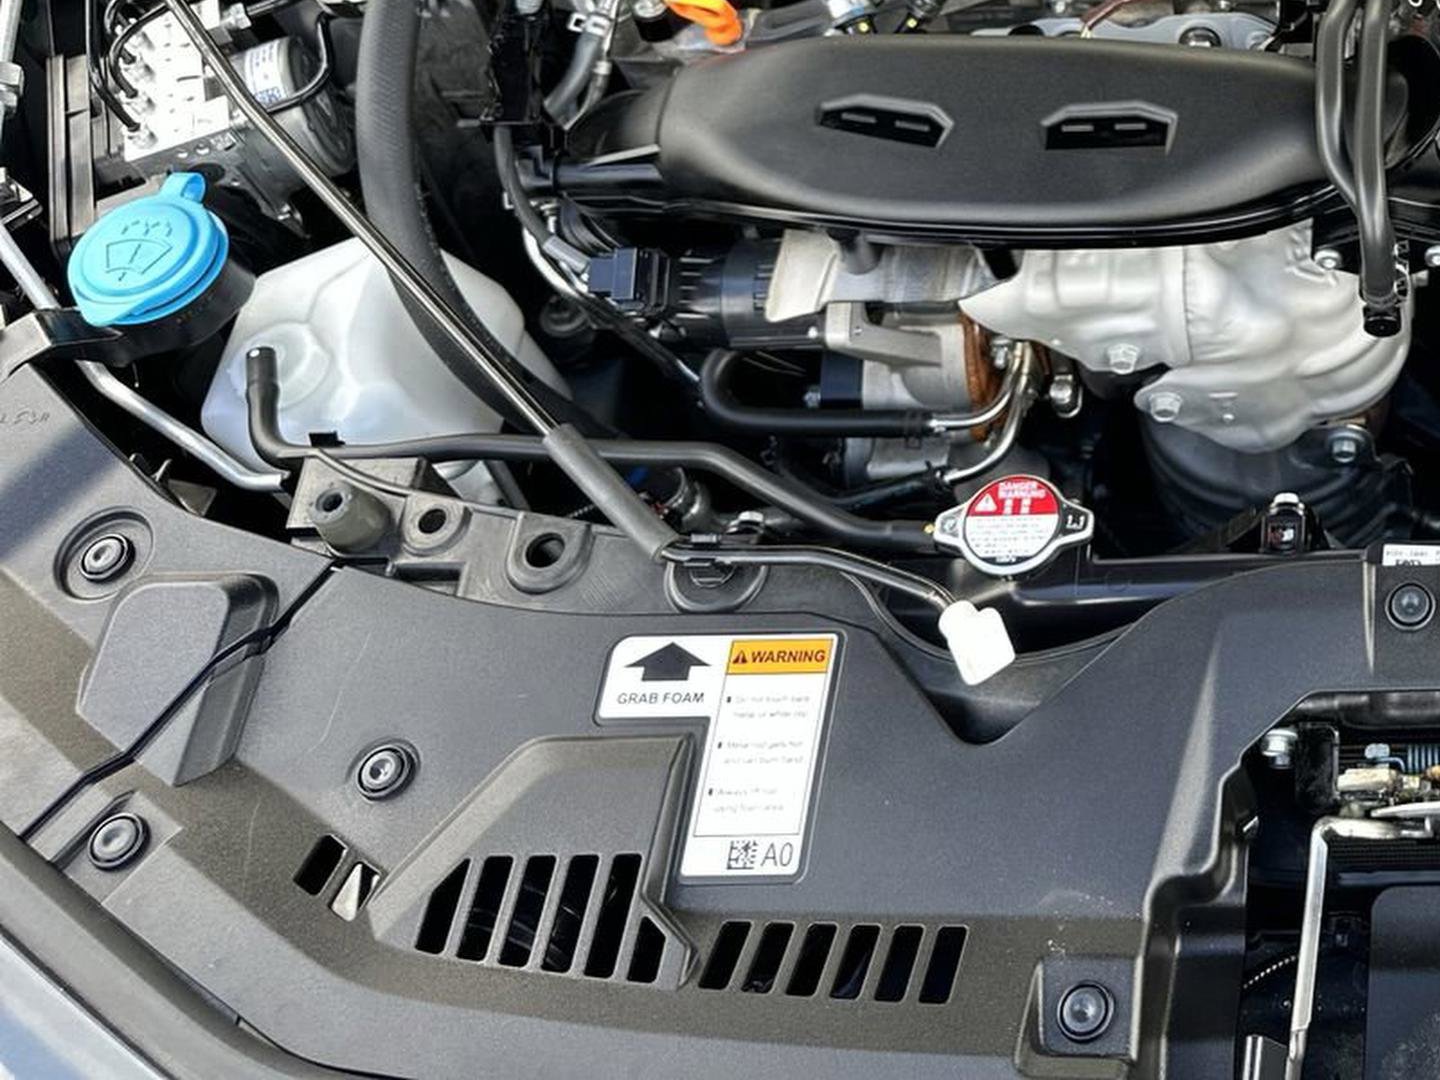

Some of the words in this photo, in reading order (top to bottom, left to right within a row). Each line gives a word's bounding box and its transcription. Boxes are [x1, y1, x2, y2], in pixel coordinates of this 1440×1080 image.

[751, 648, 825, 664] WARNING
[617, 692, 658, 705] GRAB
[663, 692, 705, 704] FOAM
